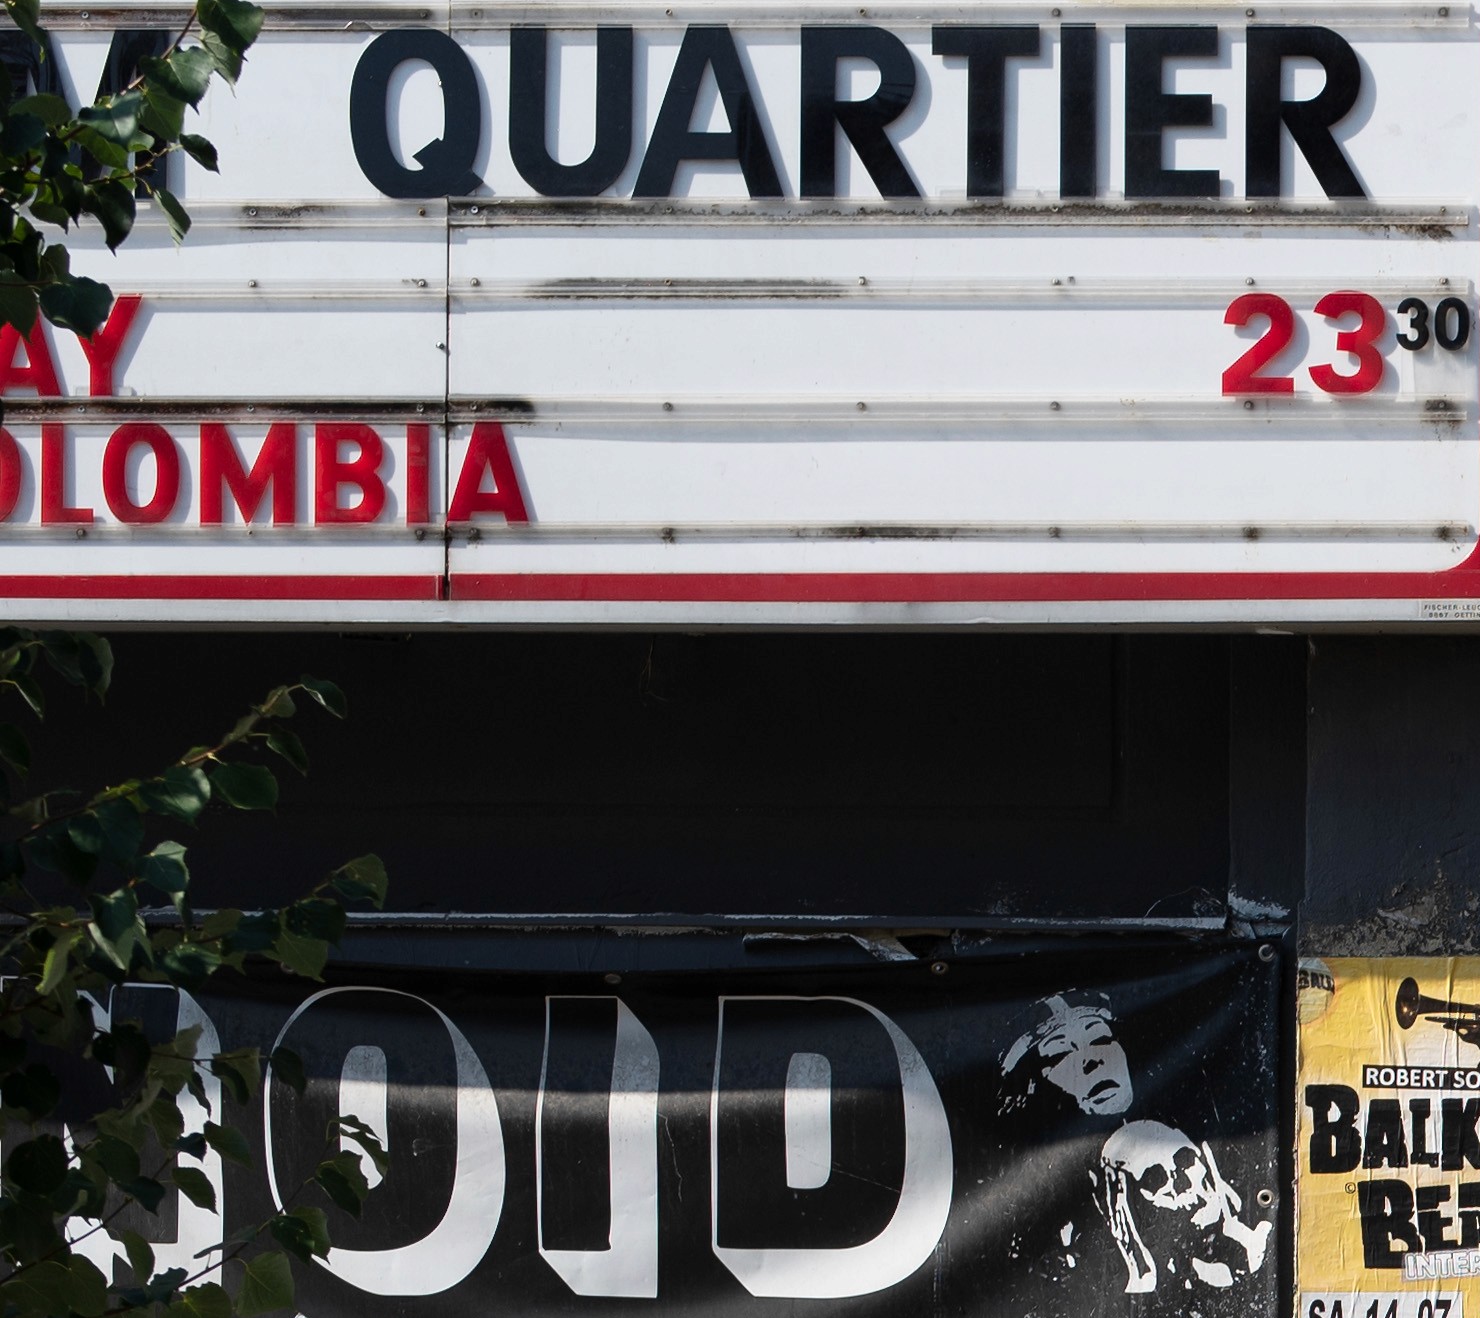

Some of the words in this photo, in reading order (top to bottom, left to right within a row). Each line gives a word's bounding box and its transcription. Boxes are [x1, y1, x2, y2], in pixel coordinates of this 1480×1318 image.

[350, 25, 1365, 200] QUARTIER
[1221, 291, 1385, 397] 23
[1396, 297, 1470, 351] 30
[1366, 1067, 1444, 1088] ROBERT
